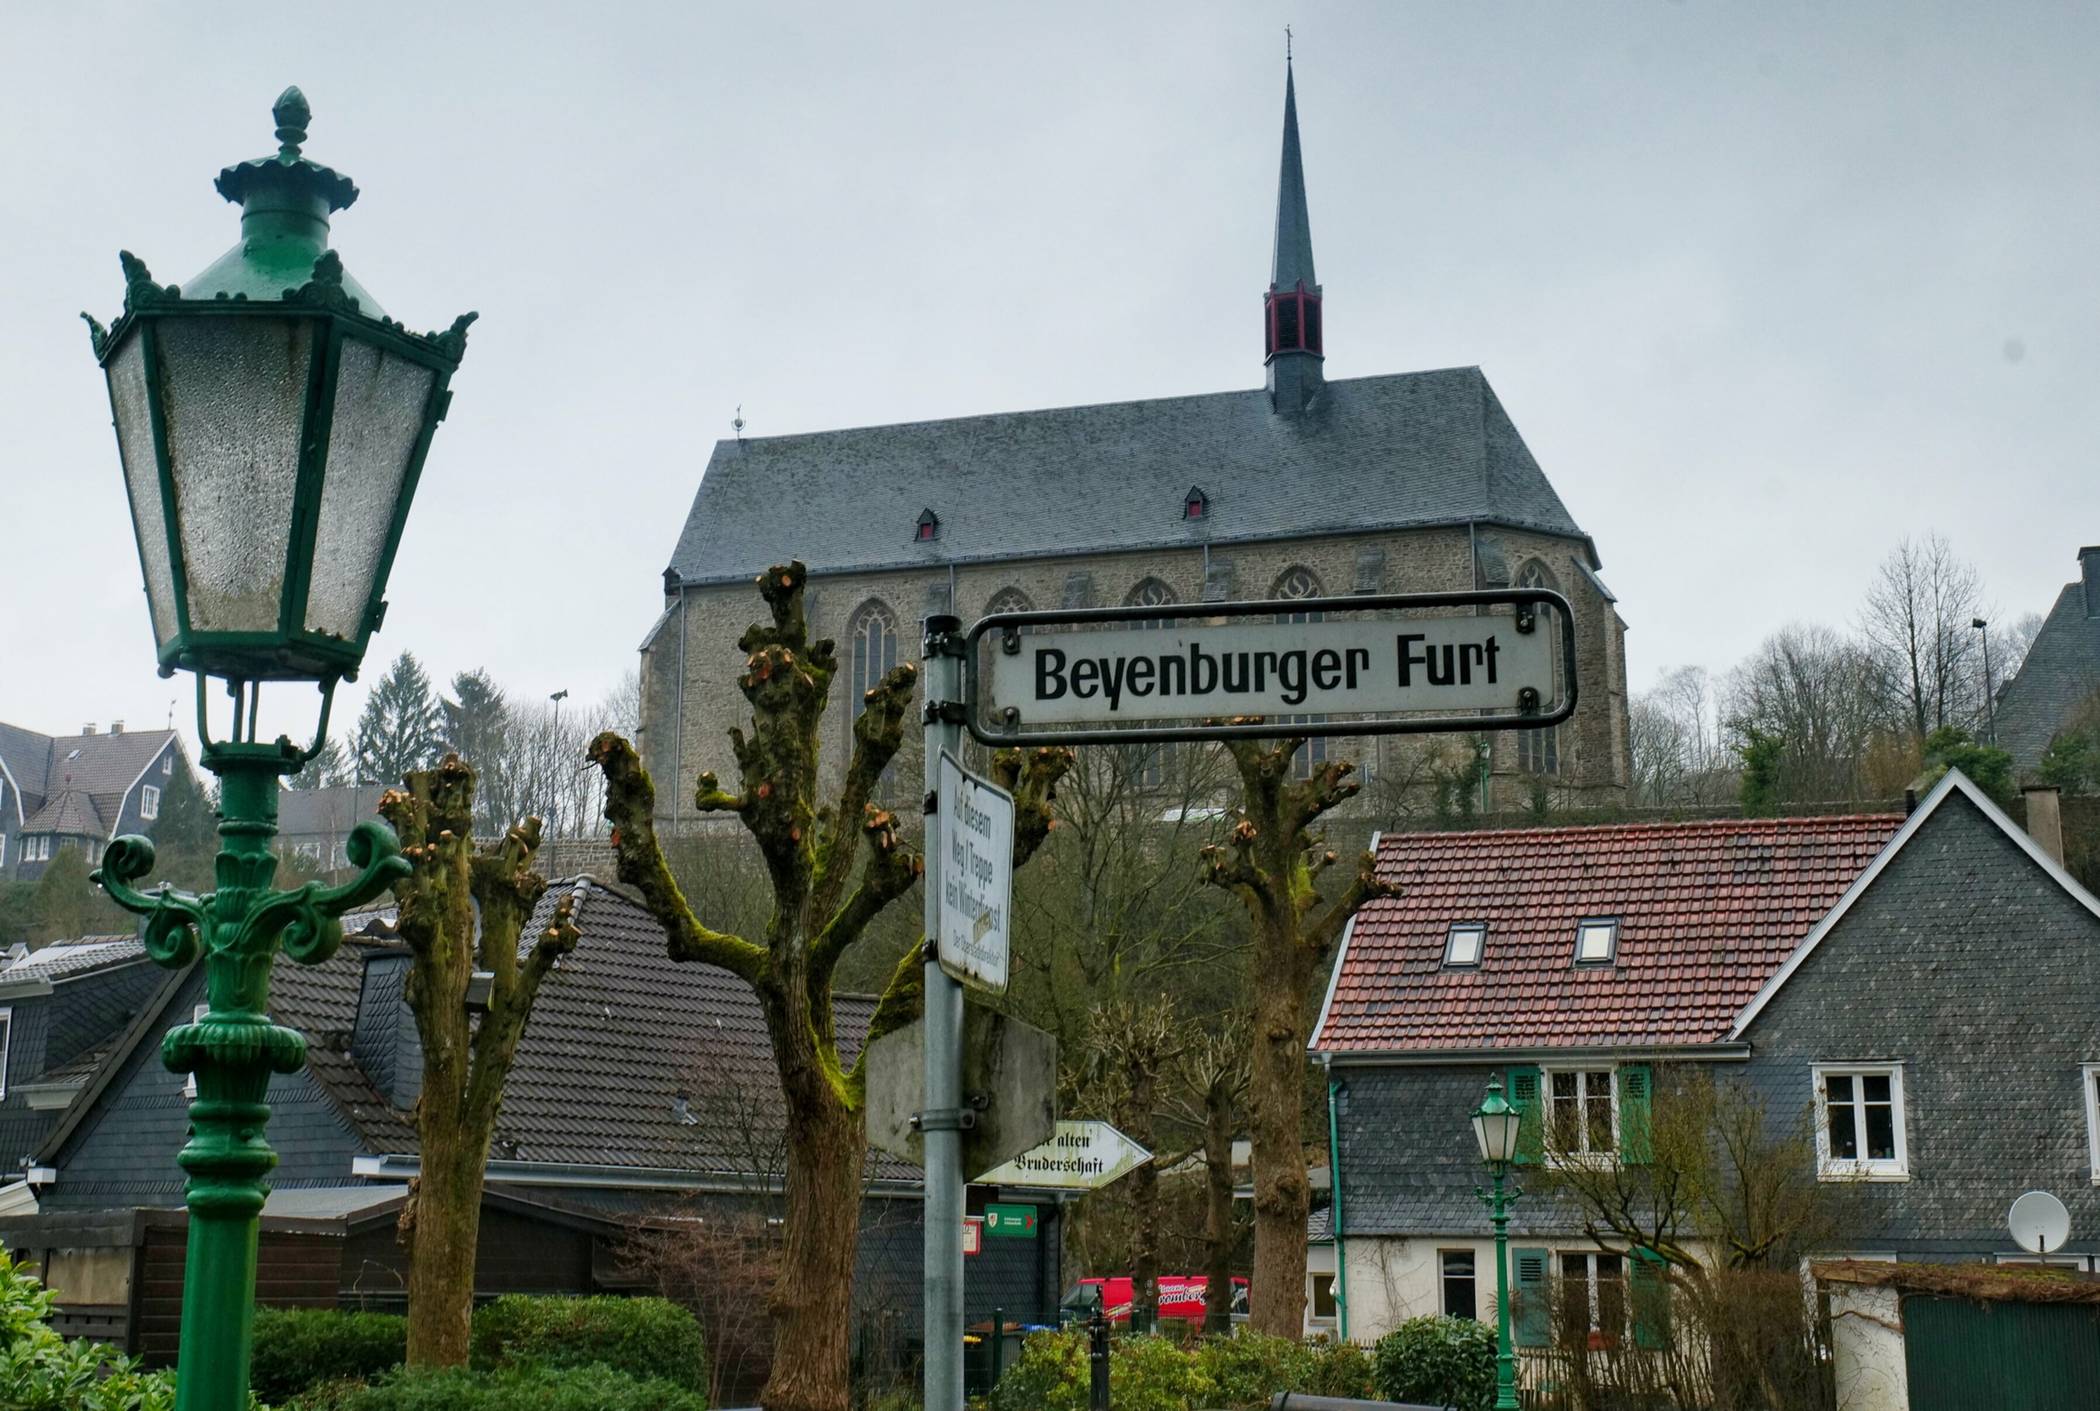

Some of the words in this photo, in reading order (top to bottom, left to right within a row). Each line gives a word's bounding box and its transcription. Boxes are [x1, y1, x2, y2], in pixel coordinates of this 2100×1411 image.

[1034, 642, 1369, 711] Beyenburger
[1396, 634, 1500, 688] Furt
[964, 794, 991, 840] diesem
[951, 827, 964, 876] Weg
[969, 842, 993, 888] Treppe
[945, 870, 959, 911] kein
[1057, 1131, 1090, 1148] alten
[1014, 1155, 1104, 1176] Bruderschaft
